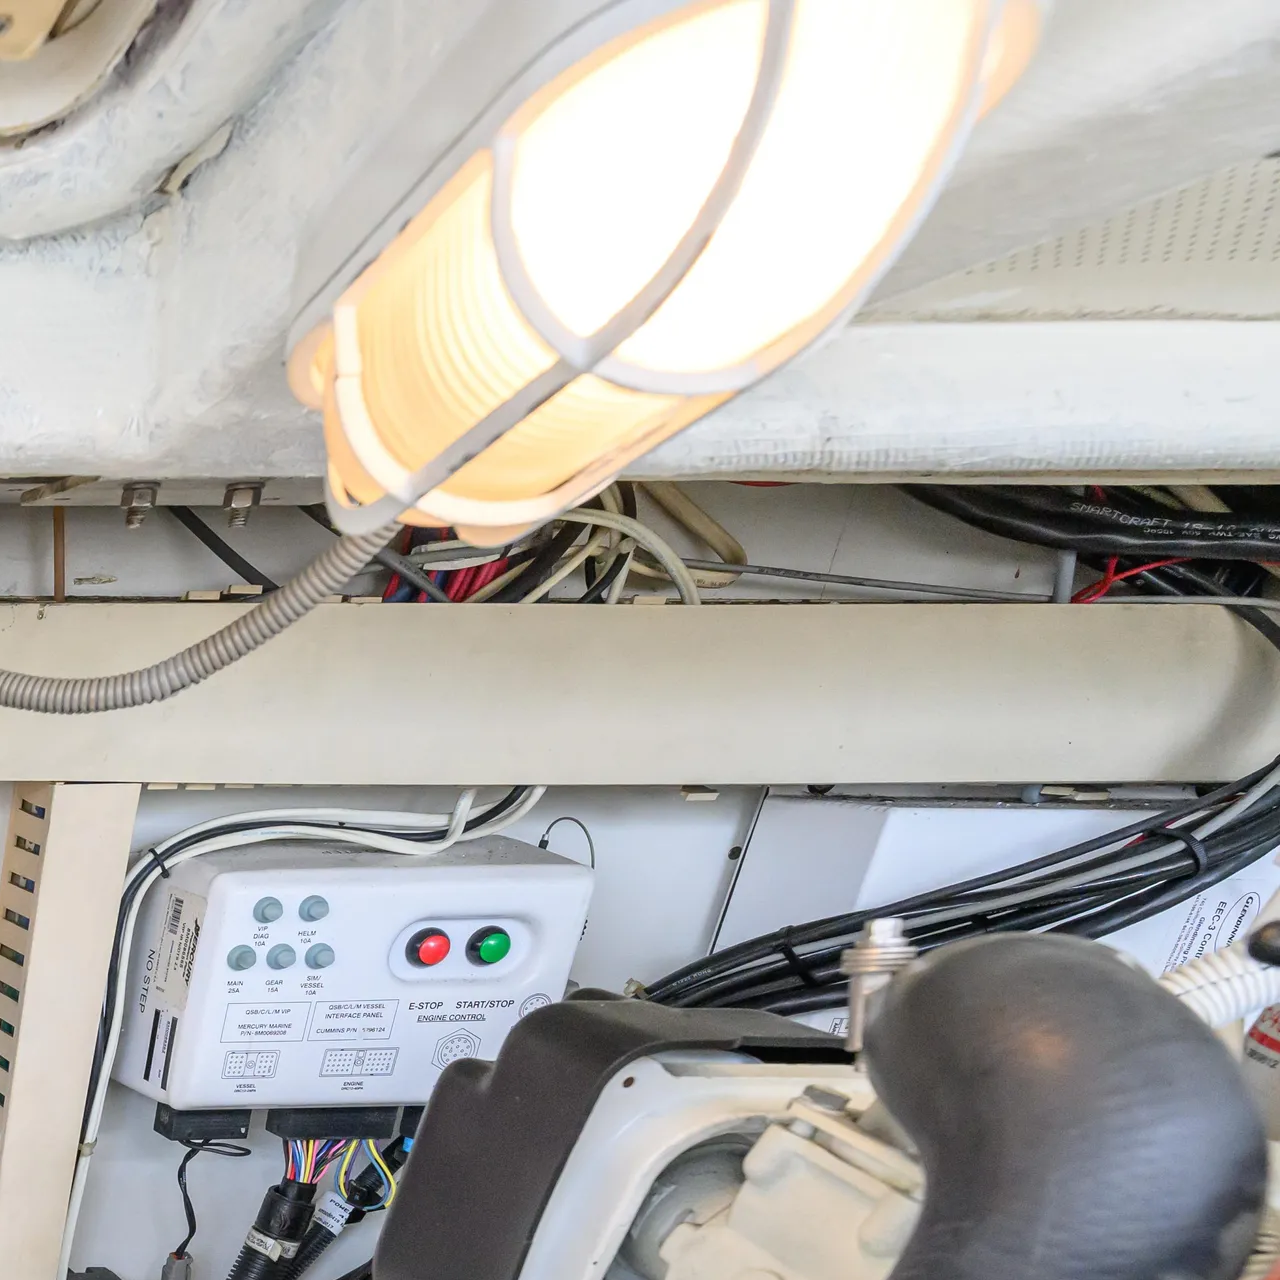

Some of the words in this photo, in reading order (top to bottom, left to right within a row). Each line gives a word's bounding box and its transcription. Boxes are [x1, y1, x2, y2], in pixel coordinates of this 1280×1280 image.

[1070, 502, 1172, 527] SMARTCRAFT
[1208, 901, 1227, 931] EEC-3
[144, 948, 155, 971] NO
[139, 975, 151, 1013] STEP
[408, 1001, 443, 1010] E-STOP
[456, 1000, 514, 1009] START/STOP
[417, 1014, 446, 1023] ENGINE
[448, 1013, 486, 1022] CONTROL
